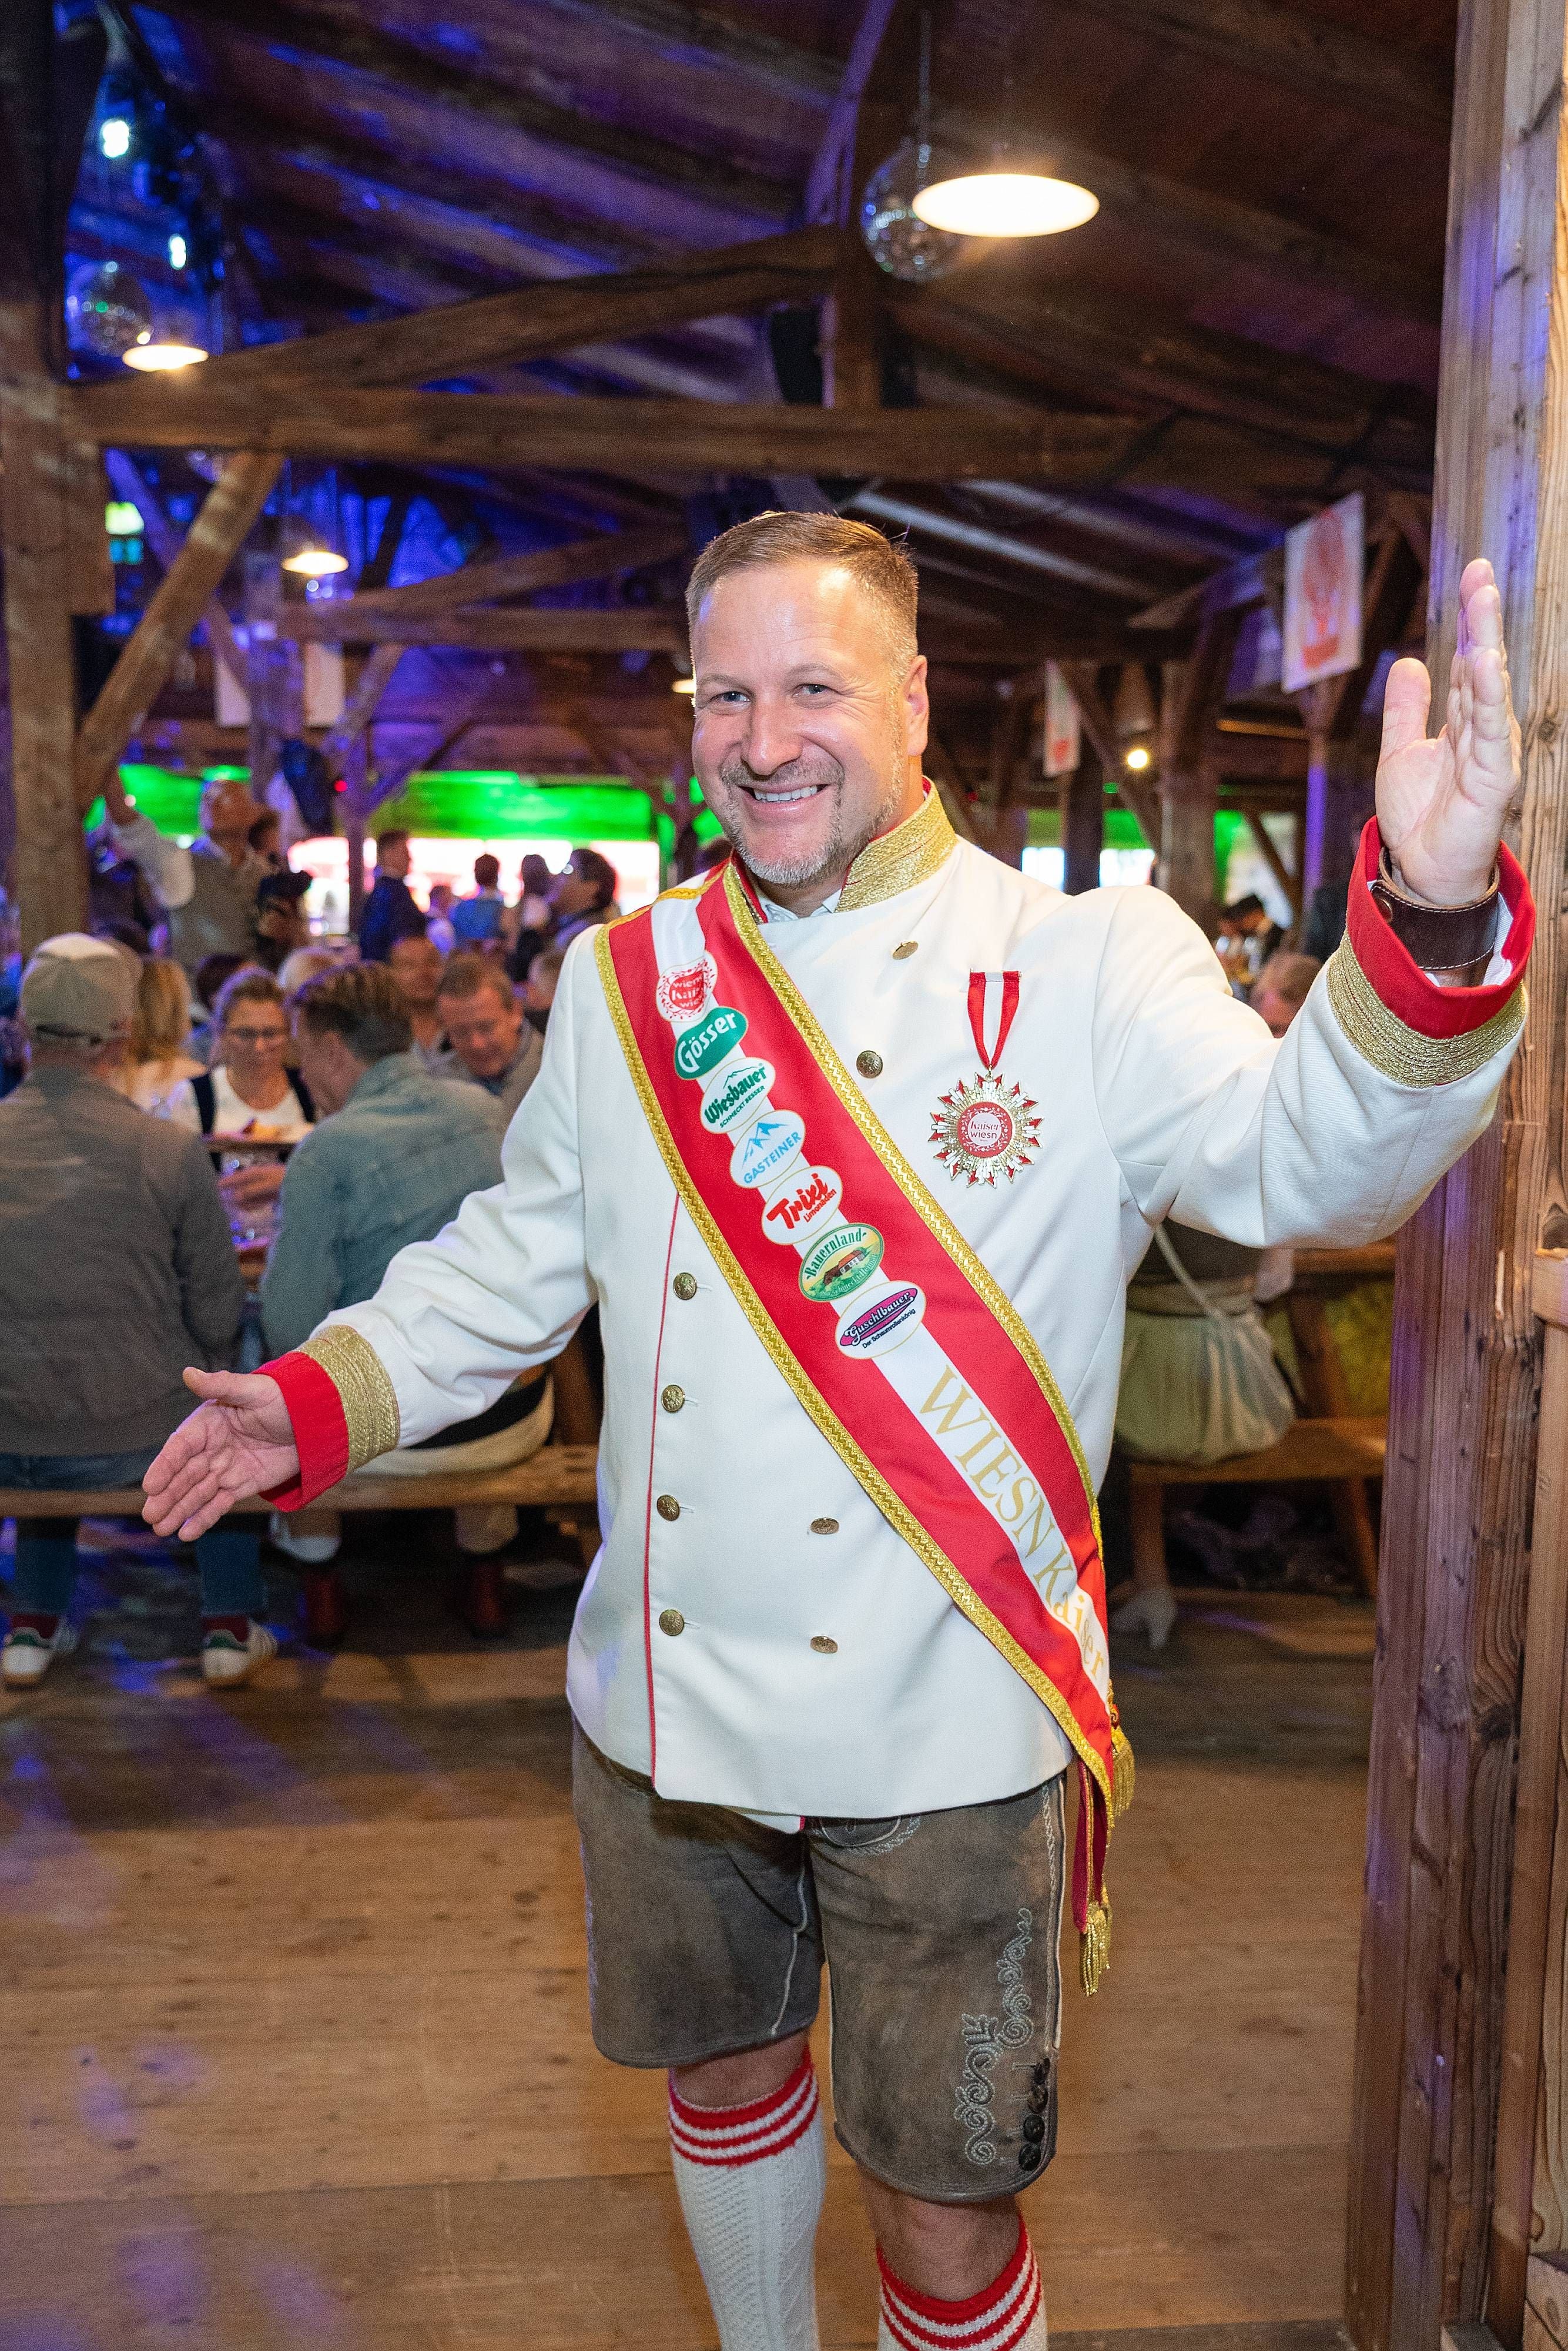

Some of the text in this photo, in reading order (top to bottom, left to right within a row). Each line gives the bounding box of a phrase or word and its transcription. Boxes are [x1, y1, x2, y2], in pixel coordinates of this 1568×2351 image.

[678, 1013, 737, 1073] Gösser
[704, 1066, 767, 1124] Wiesbauer
[719, 1086, 765, 1128] SCHMECKT BESSER
[743, 1131, 802, 1184] GASTEINER
[970, 1130, 997, 1139] wiesn
[766, 1173, 828, 1229] Trixi
[803, 1188, 837, 1223] Limonaden
[804, 1228, 862, 1277] Bauernland
[844, 1291, 913, 1347] Guschlbauer
[862, 1308, 916, 1349] Der Schaumrollenkönig
[919, 1364, 1056, 1559] WIESN
